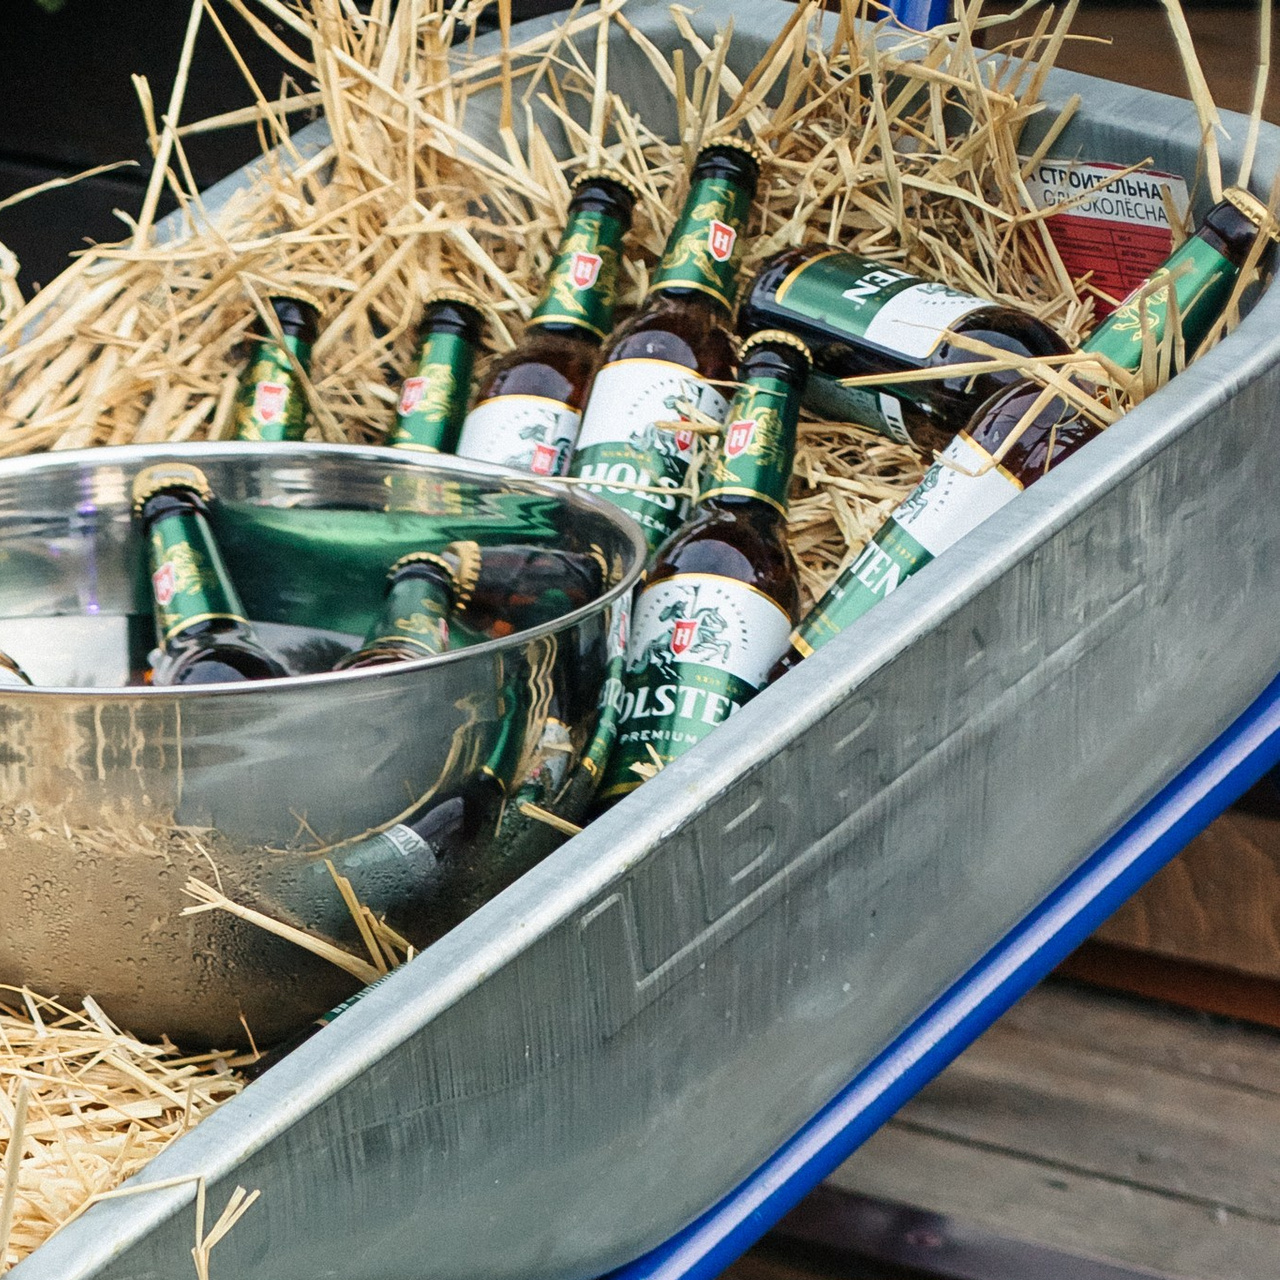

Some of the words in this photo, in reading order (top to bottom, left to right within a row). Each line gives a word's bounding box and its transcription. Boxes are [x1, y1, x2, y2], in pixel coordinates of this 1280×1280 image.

[1039, 166, 1172, 201] СТРОИТЕЛЬНА
[714, 230, 730, 253] H
[730, 428, 748, 448] H
[578, 461, 686, 518] HOLS
[674, 627, 692, 646] H
[619, 729, 698, 746] PREMIUM
